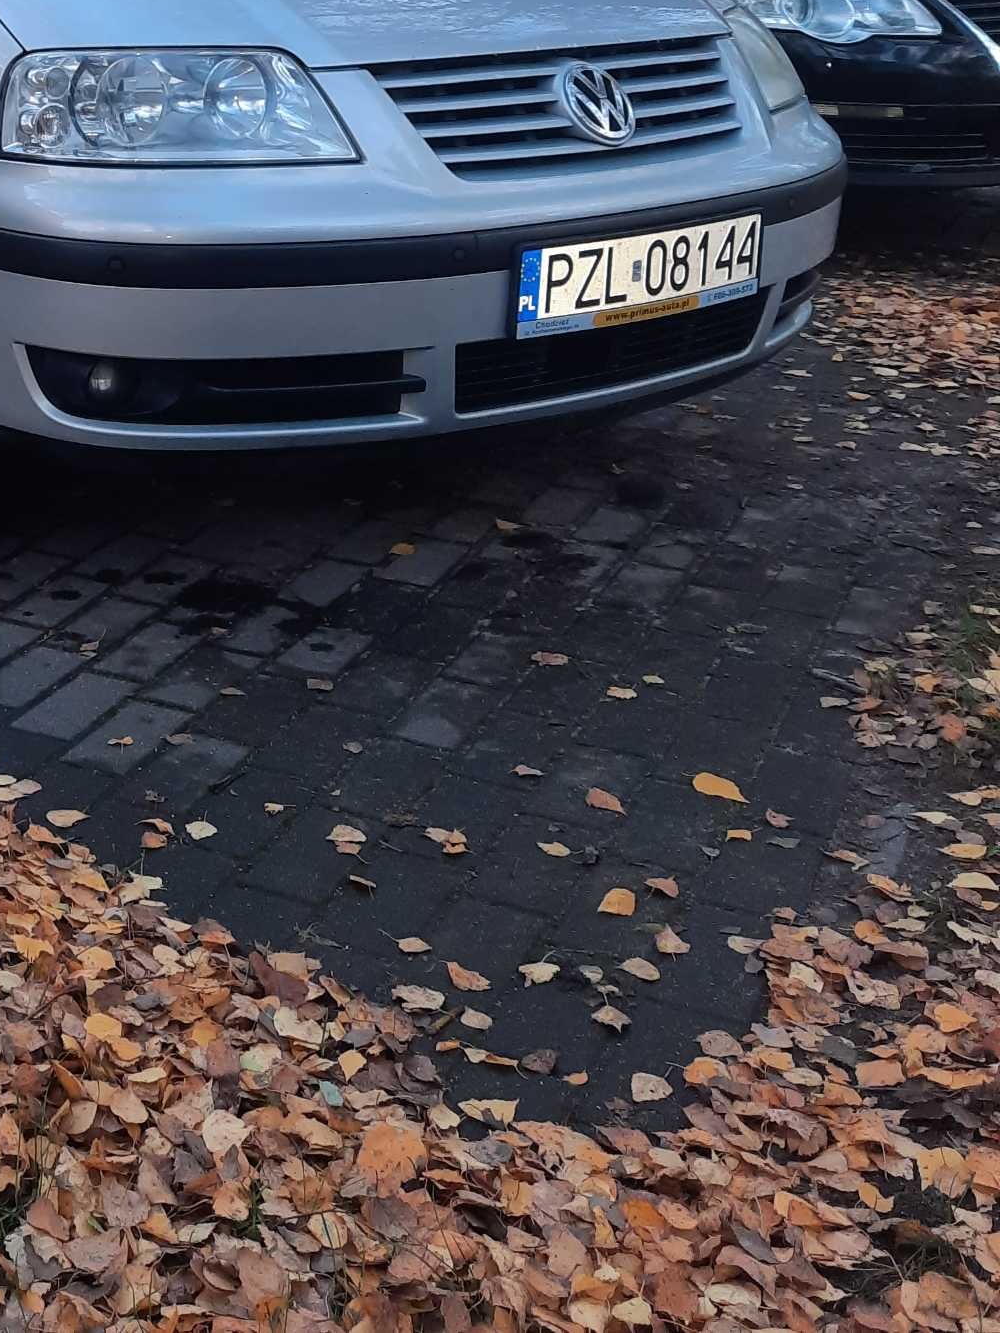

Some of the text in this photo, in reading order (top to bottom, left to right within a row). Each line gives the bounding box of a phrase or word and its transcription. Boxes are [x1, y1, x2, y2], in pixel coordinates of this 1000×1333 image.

[565, 63, 633, 144] VW
[545, 221, 757, 314] PZL 08144
[518, 295, 536, 312] PL
[605, 298, 691, 322] www.primus-auta.pl
